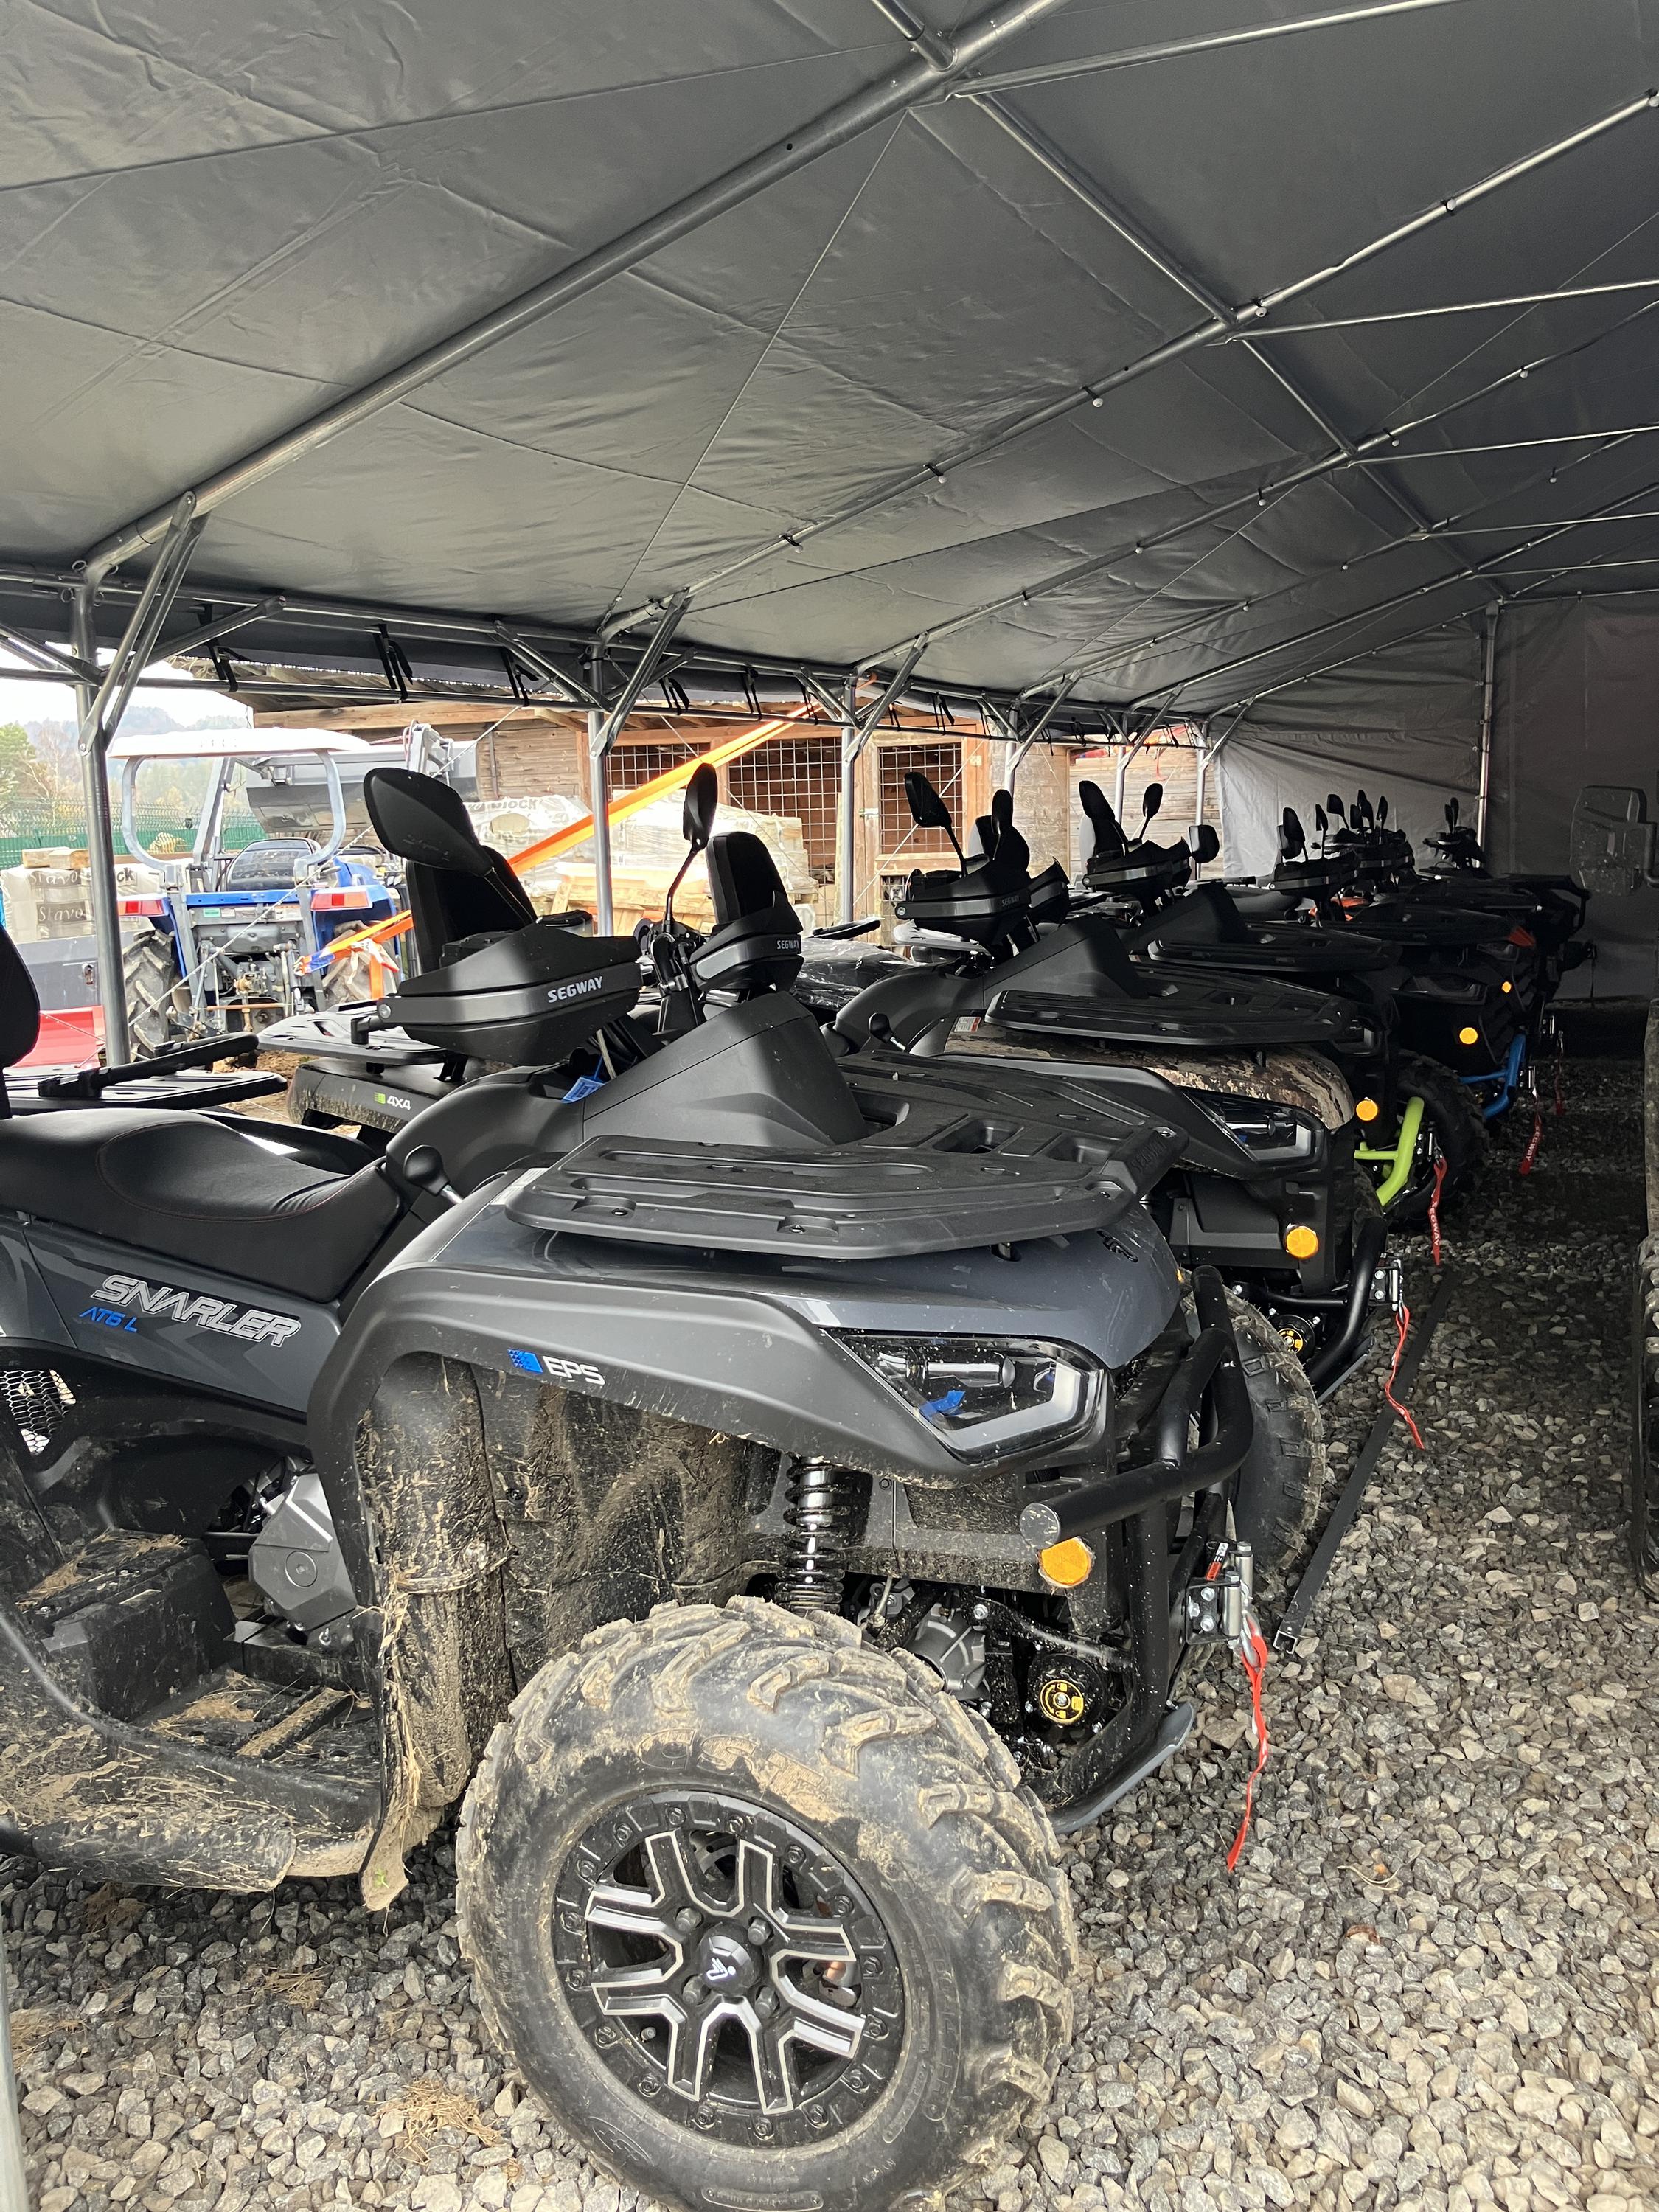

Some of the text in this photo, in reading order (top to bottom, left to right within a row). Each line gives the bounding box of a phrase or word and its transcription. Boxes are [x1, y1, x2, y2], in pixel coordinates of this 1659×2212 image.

[38, 906, 83, 922] Stavo
[776, 939, 800, 950] SEGWAY
[547, 975, 603, 1004] SEGWAY
[386, 1095, 411, 1110] 4X4
[79, 1306, 138, 1332] AT6 L
[90, 1274, 302, 1348] SNARLER
[542, 1355, 605, 1385] EPS
